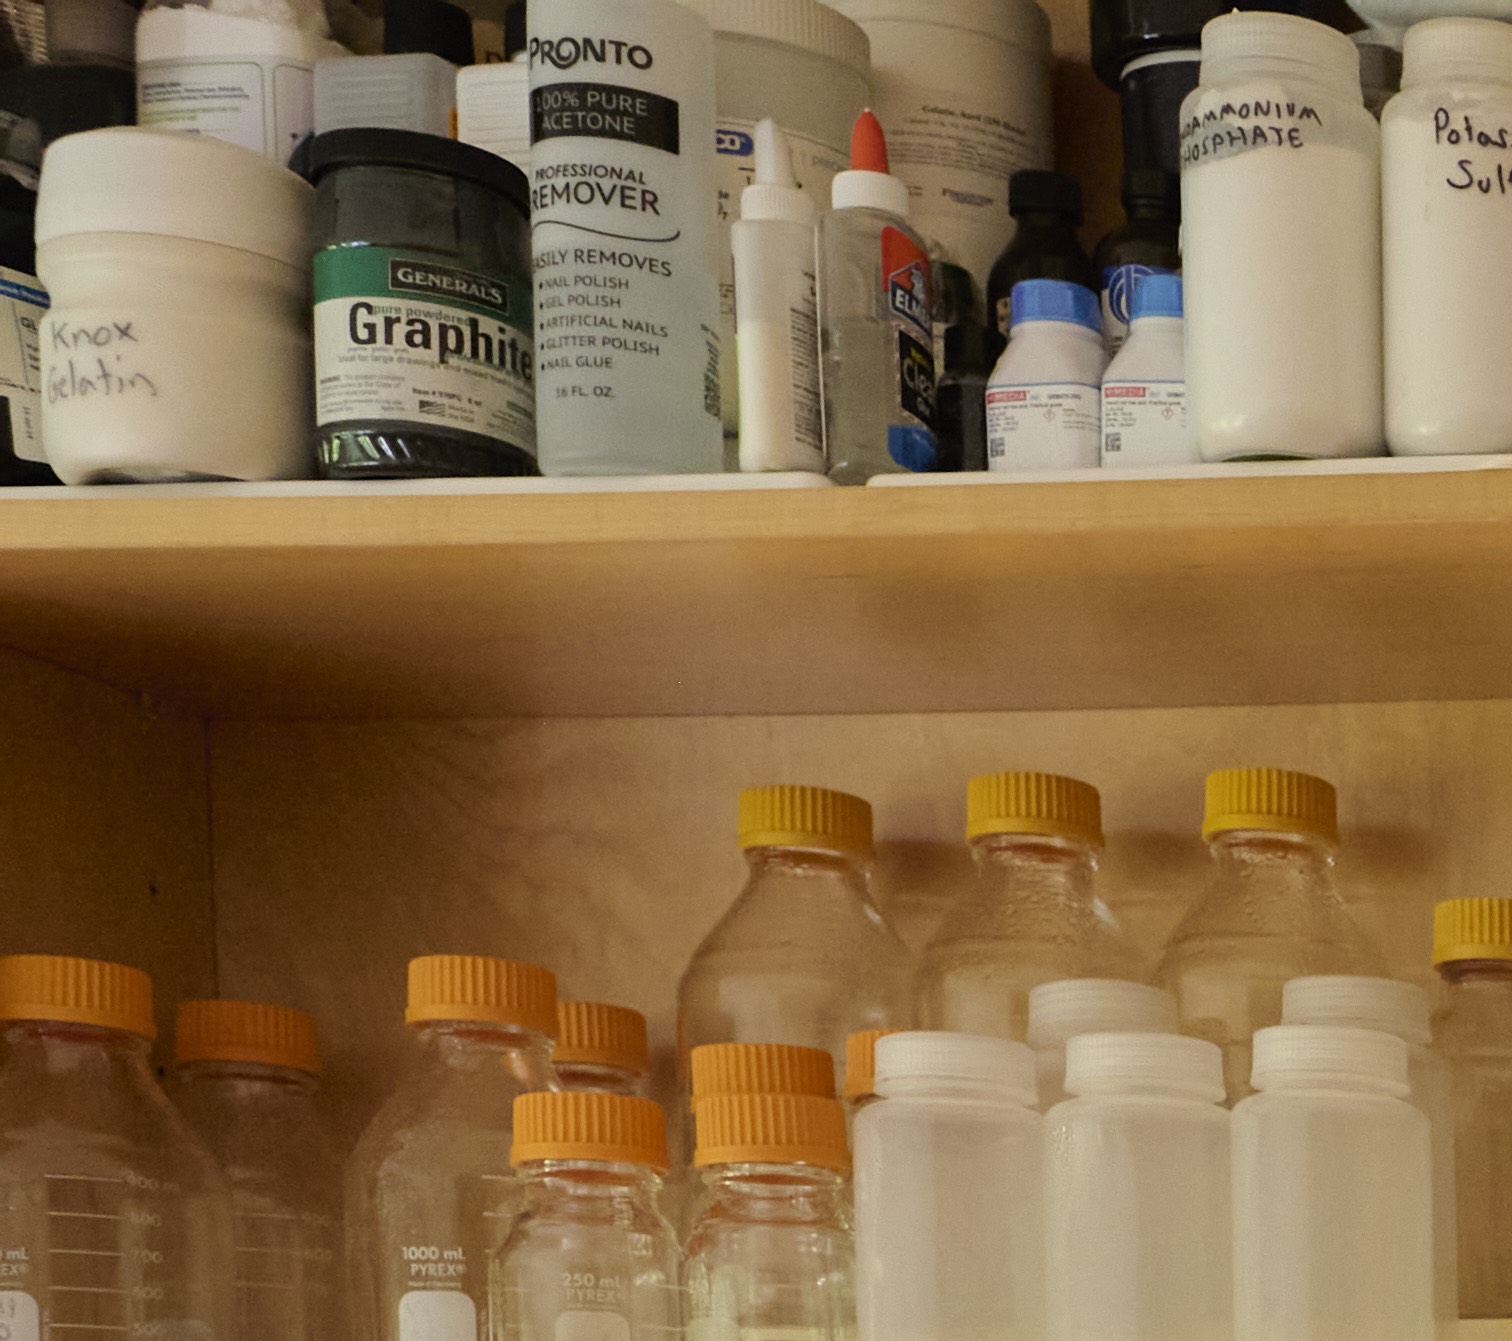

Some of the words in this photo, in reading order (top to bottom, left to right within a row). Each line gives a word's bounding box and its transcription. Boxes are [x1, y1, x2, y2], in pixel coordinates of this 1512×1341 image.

[530, 37, 653, 70] PRONTO
[536, 91, 579, 112] 100%
[587, 91, 648, 116] PURE
[542, 112, 636, 135] ACETONE
[535, 164, 646, 185] PROFESSIONAL
[532, 181, 660, 215] REMOVER
[574, 249, 672, 277] REMOVES
[545, 277, 570, 287] NAIL
[574, 275, 629, 290] POLISH
[568, 295, 621, 308] POLISH
[373, 304, 401, 315] pure
[406, 308, 471, 326] powdered
[547, 315, 617, 328] ARTIFICIAL
[623, 319, 668, 337] NAILS
[51, 321, 138, 352] Knox
[350, 302, 533, 381] Graphite
[547, 337, 596, 348] GLITTER
[602, 336, 660, 356] POLISH
[547, 358, 573, 368] NAIL
[575, 356, 613, 368] GLUE
[403, 1246, 439, 1260] 1000
[444, 1248, 465, 1259] mL
